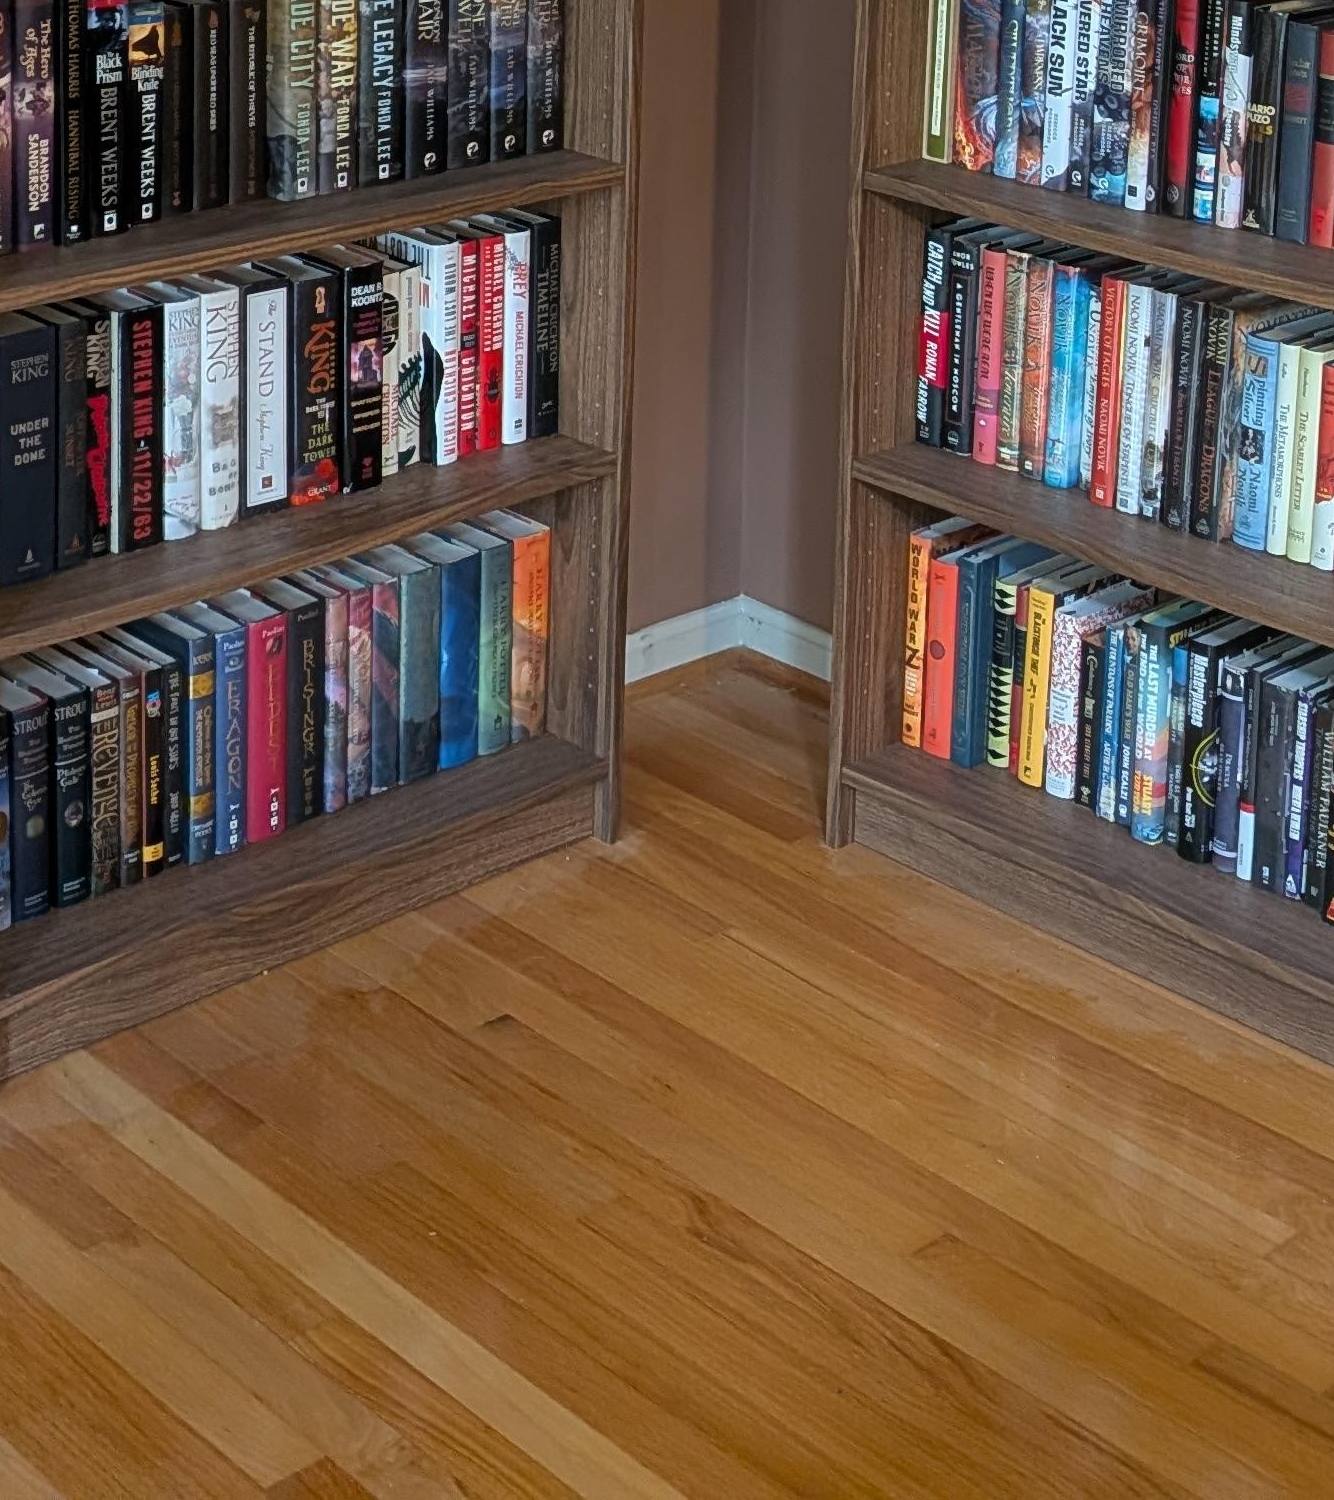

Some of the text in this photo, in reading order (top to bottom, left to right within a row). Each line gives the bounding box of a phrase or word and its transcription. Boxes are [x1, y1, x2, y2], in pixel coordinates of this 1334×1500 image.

[373, 18, 395, 88] LEGACY
[1048, 52, 1066, 97] SUN
[140, 94, 155, 198] BRENT WEEKS
[378, 91, 391, 161] FONDA LEE
[513, 262, 527, 299] PREY
[922, 241, 943, 337] CATCH AND KILL
[132, 320, 153, 437] STEPHEN KING
[258, 321, 275, 397] STAND
[514, 311, 524, 400] MICHAEL CRICHTON
[925, 340, 939, 380] RONAN
[917, 375, 928, 422] FARROW
[132, 452, 152, 540] 11/22/63
